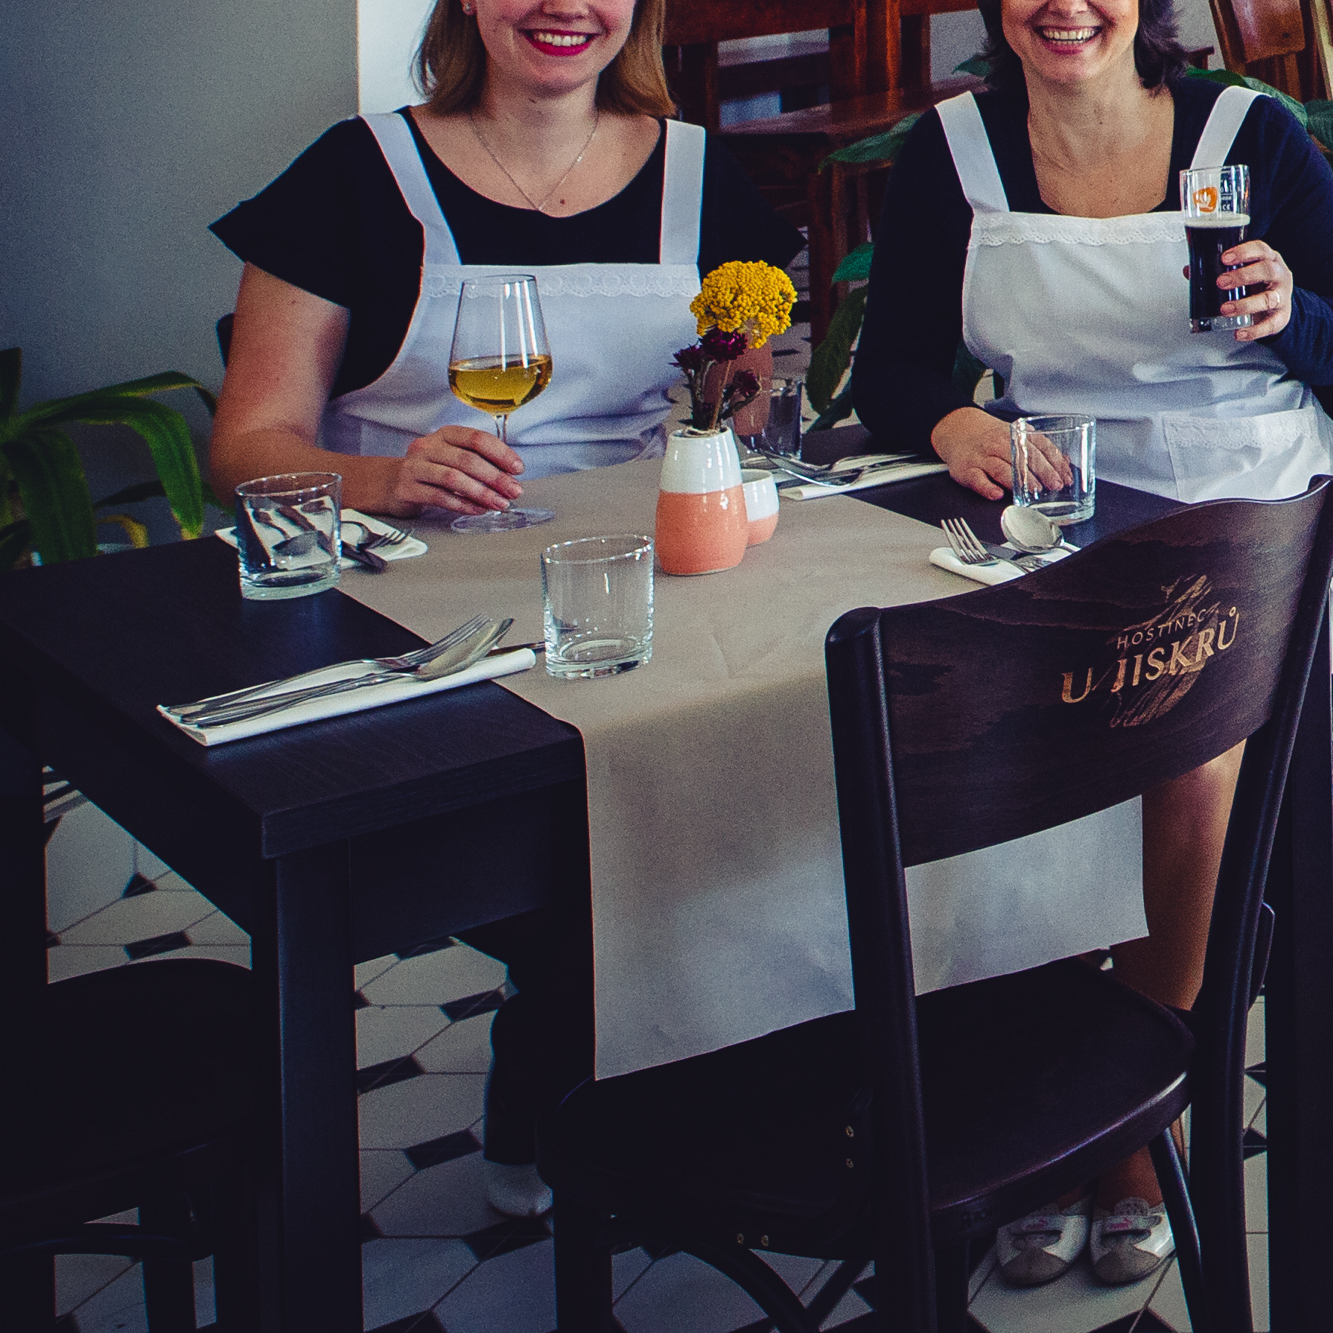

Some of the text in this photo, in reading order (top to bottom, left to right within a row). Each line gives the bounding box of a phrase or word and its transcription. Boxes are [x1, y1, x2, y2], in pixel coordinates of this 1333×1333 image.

[1062, 606, 1239, 703] U JISKRŮ
[1117, 609, 1206, 649] HOSTINEC
